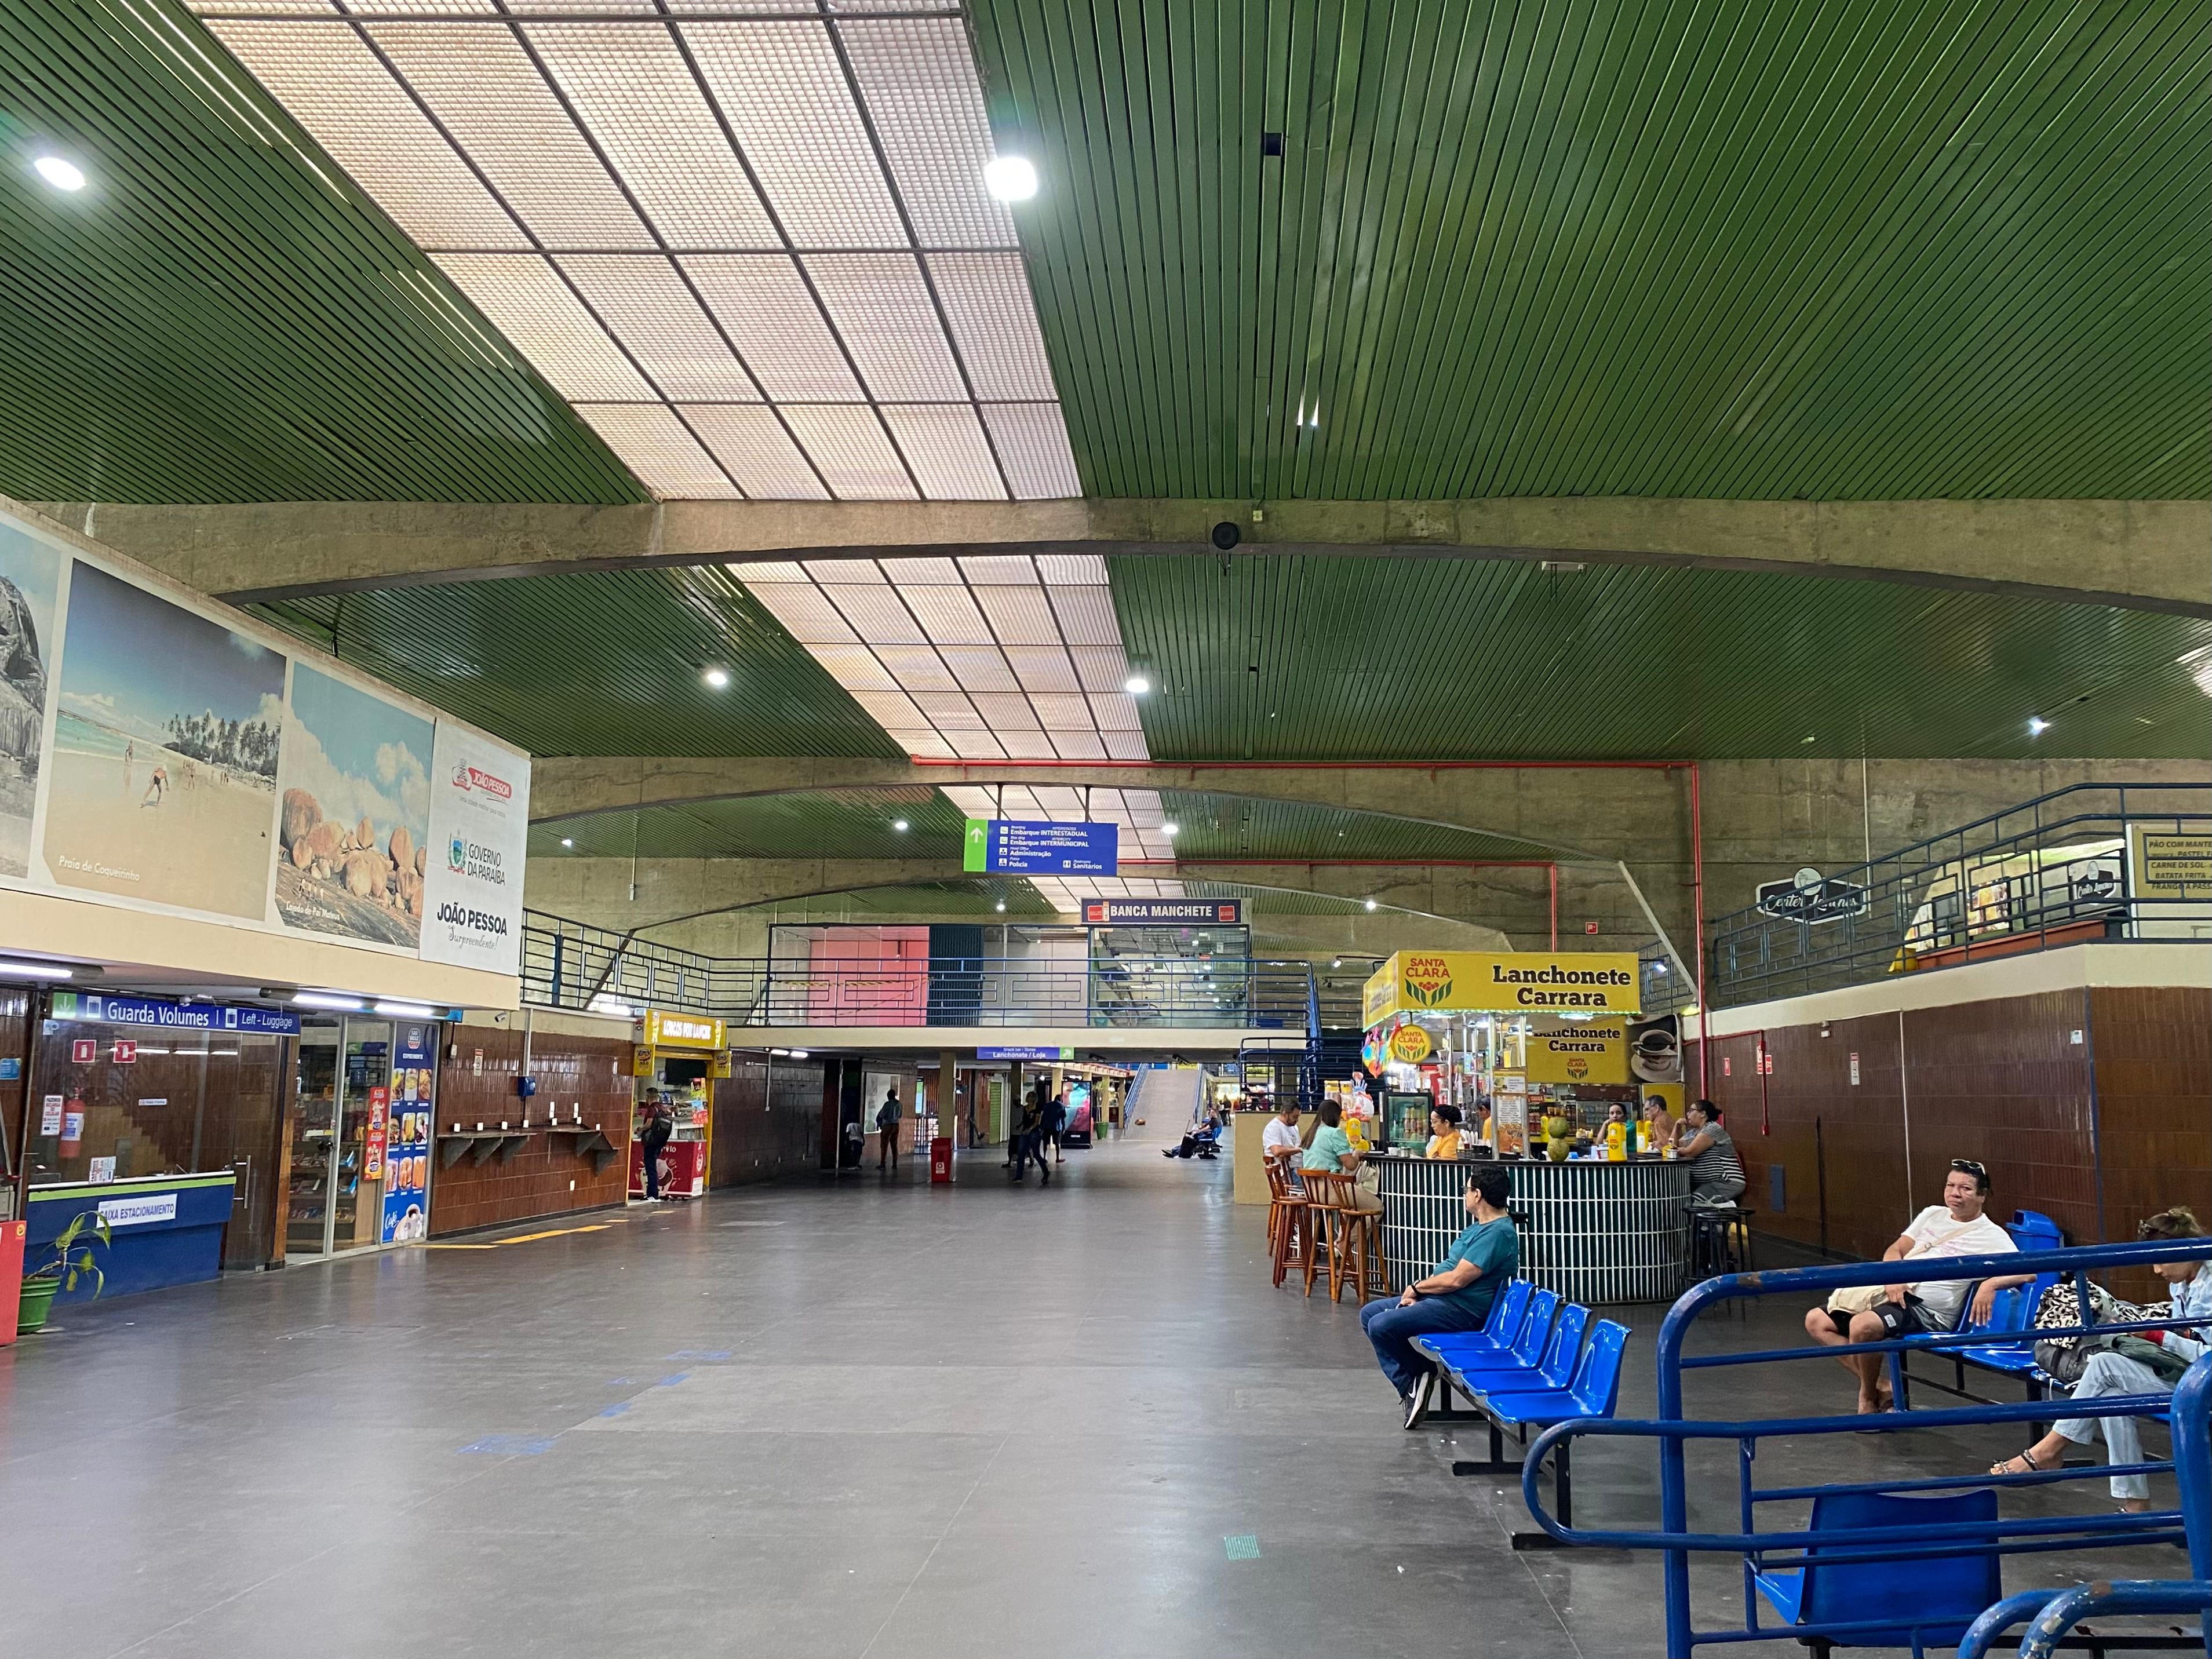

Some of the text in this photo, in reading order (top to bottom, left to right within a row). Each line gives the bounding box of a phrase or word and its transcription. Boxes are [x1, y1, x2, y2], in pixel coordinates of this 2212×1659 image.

[473, 772, 489, 787] JOÃO
[488, 779, 509, 797] PESSOA
[2149, 839, 2164, 848] PÃO
[469, 844, 501, 866] GOVERNO
[59, 855, 140, 881] Praia de Coqueirinho
[468, 861, 505, 886] DA PARAÍBA
[437, 902, 507, 936] JOÃO PESSOA
[1110, 906, 1147, 917] BANCA
[1151, 906, 1212, 917] MANCHETE
[448, 925, 500, 950] Surpreendente!
[1405, 967, 1451, 978] CLARA
[1410, 958, 1446, 967] SANTA
[1493, 964, 1631, 985] Lanchonete
[1517, 987, 1608, 1007] Carrara
[108, 1002, 155, 1024] Guarda
[159, 1007, 209, 1026] Volumes
[242, 1012, 257, 1025] Left
[262, 1014, 293, 1029] Luggage
[1548, 1040, 1606, 1052] Carrara
[120, 1204, 174, 1219] ESTACIONAMENTO
